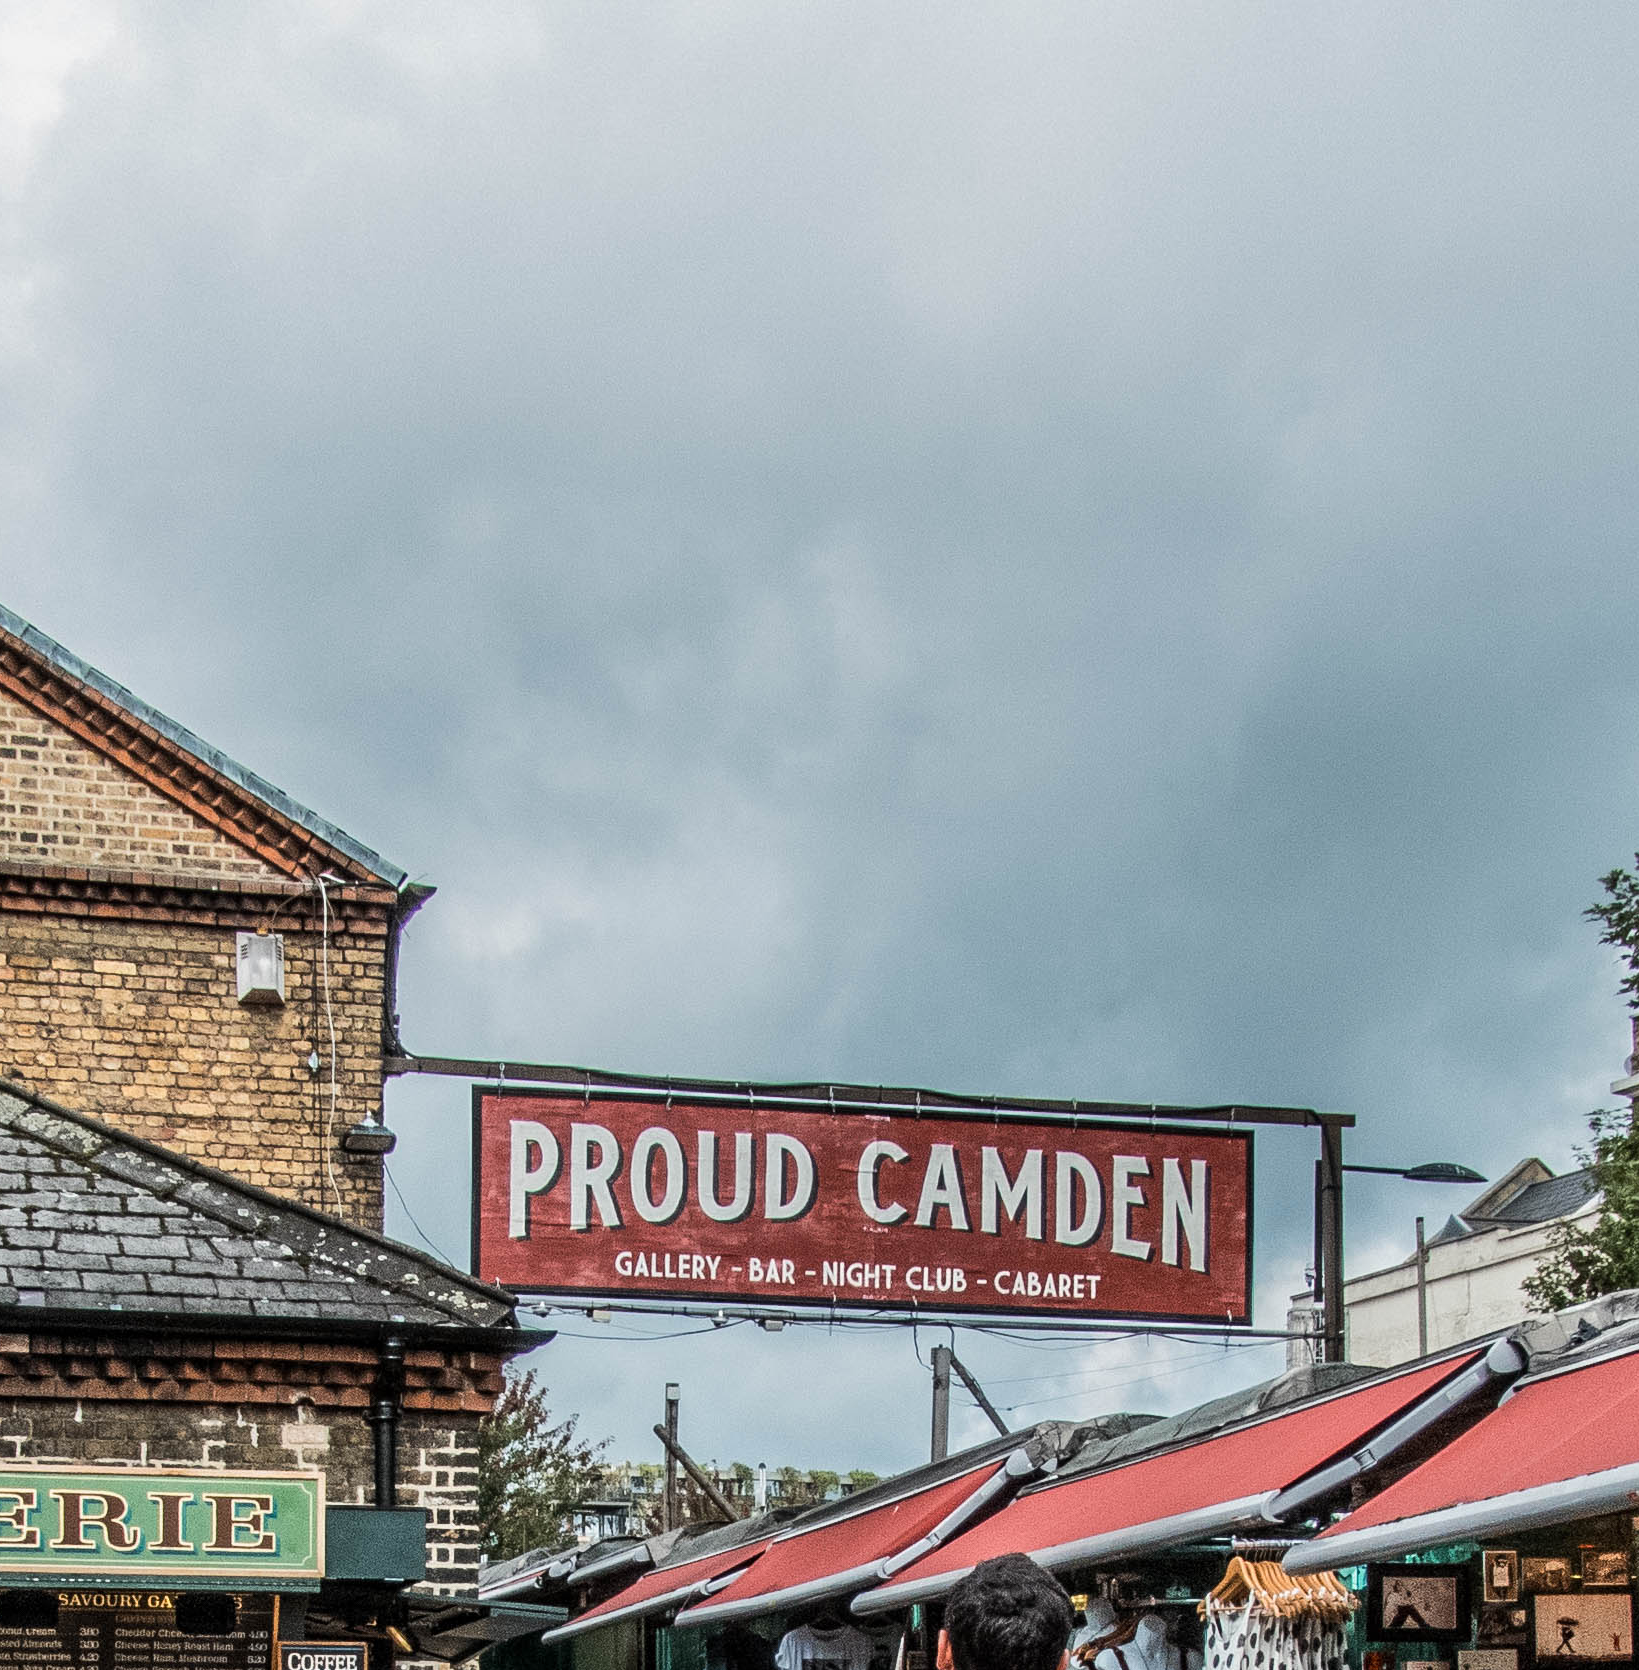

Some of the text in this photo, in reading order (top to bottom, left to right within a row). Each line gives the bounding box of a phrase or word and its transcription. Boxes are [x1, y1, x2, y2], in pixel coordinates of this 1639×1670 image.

[508, 1119, 1210, 1273] PROUD CAMDEN
[615, 1251, 1101, 1301] GALLERY BAR NIGHT CLUB CABARET
[59, 1594, 142, 1607] SAVOURY
